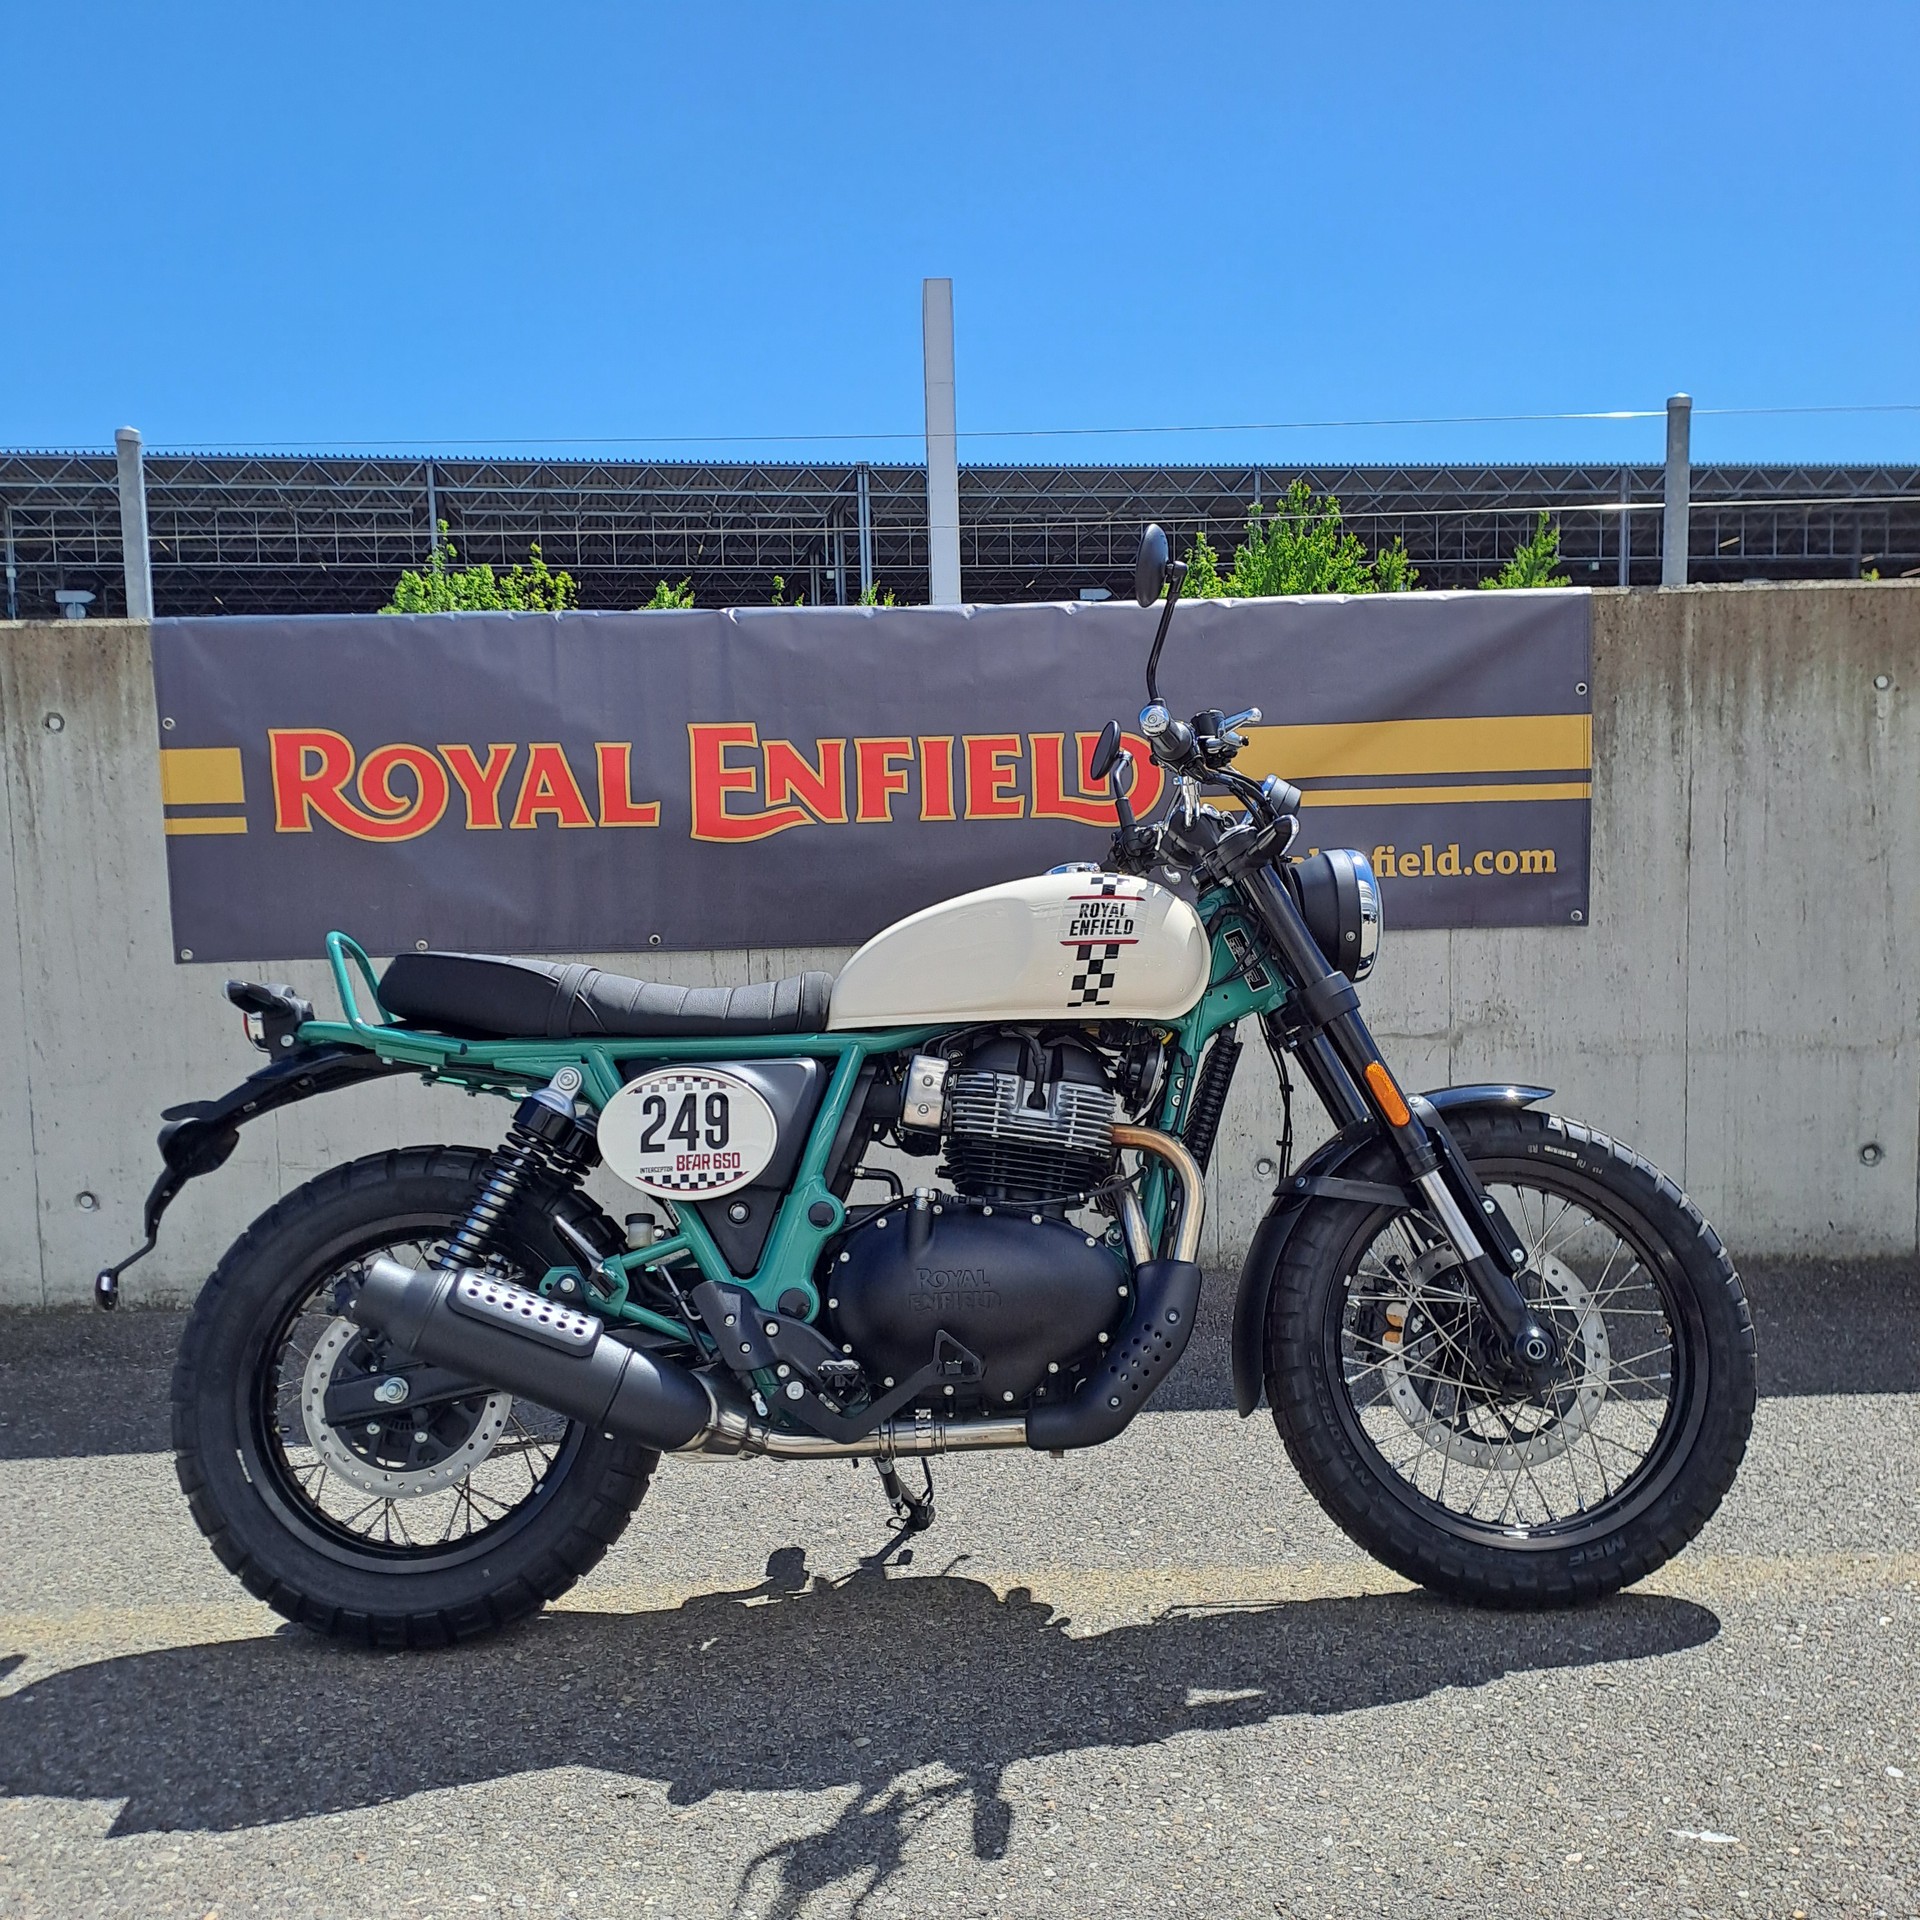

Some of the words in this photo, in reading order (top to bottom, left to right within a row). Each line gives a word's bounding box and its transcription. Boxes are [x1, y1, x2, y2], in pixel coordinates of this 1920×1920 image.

[267, 727, 661, 843] ROYAL
[687, 721, 1165, 843] ENFIELD
[1079, 902, 1128, 919] ROYAL
[1069, 919, 1134, 936] ENFIELD
[640, 1091, 730, 1154] 249
[639, 1165, 674, 1174] INTERCEPTOR
[676, 1153, 711, 1172] BEAR
[712, 1151, 741, 1170] 650
[915, 1267, 991, 1290] ROYAL
[908, 1290, 1002, 1312] ENFIELD
[1567, 1535, 1627, 1567] MRF
